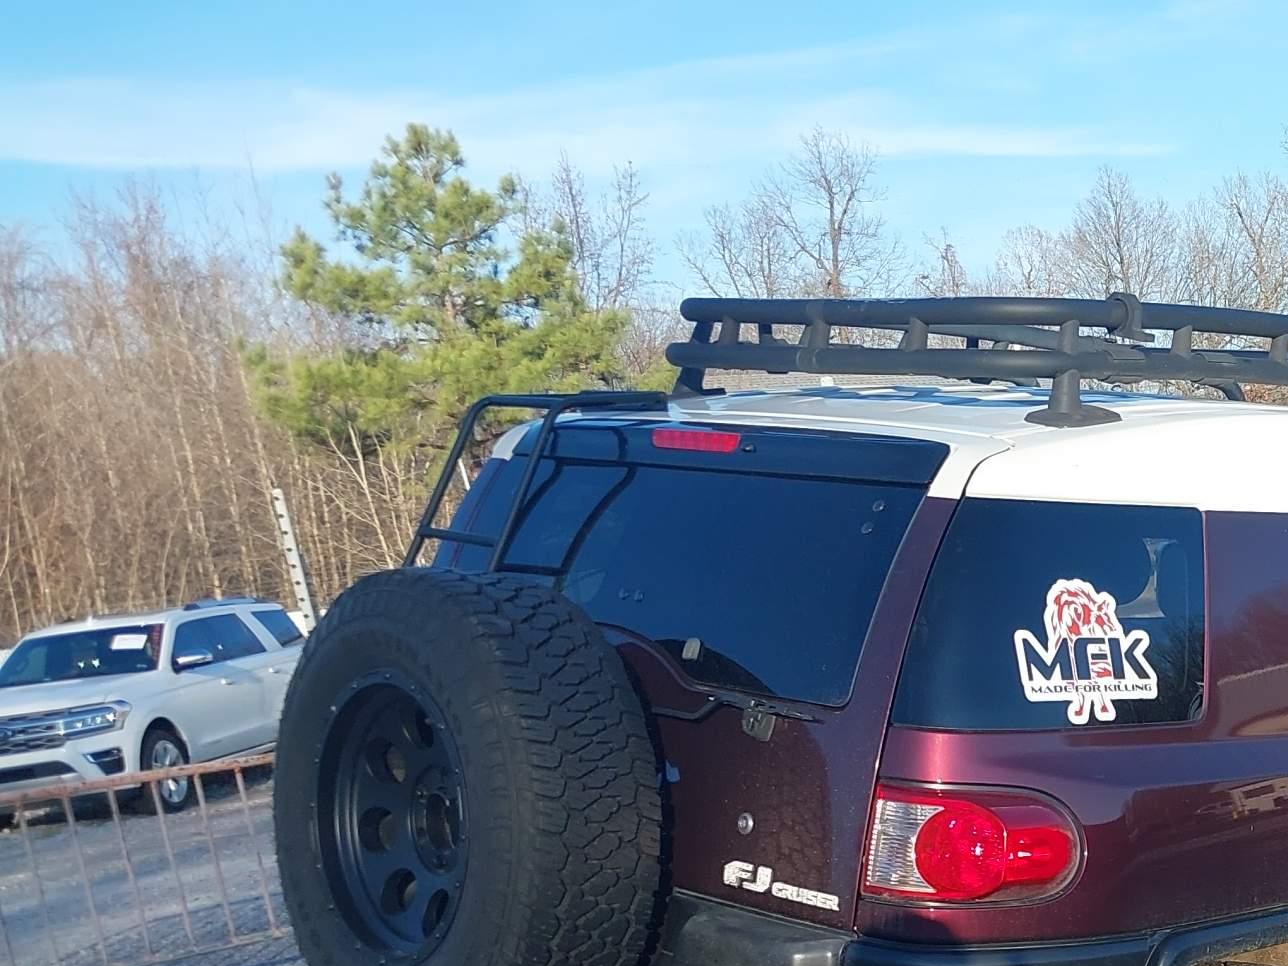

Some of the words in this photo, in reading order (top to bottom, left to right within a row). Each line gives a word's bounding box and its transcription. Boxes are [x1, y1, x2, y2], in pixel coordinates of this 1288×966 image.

[1031, 684, 1075, 694] MADE
[1075, 683, 1101, 693] FOR
[1104, 682, 1152, 692] KILLING
[723, 860, 772, 893] FJ
